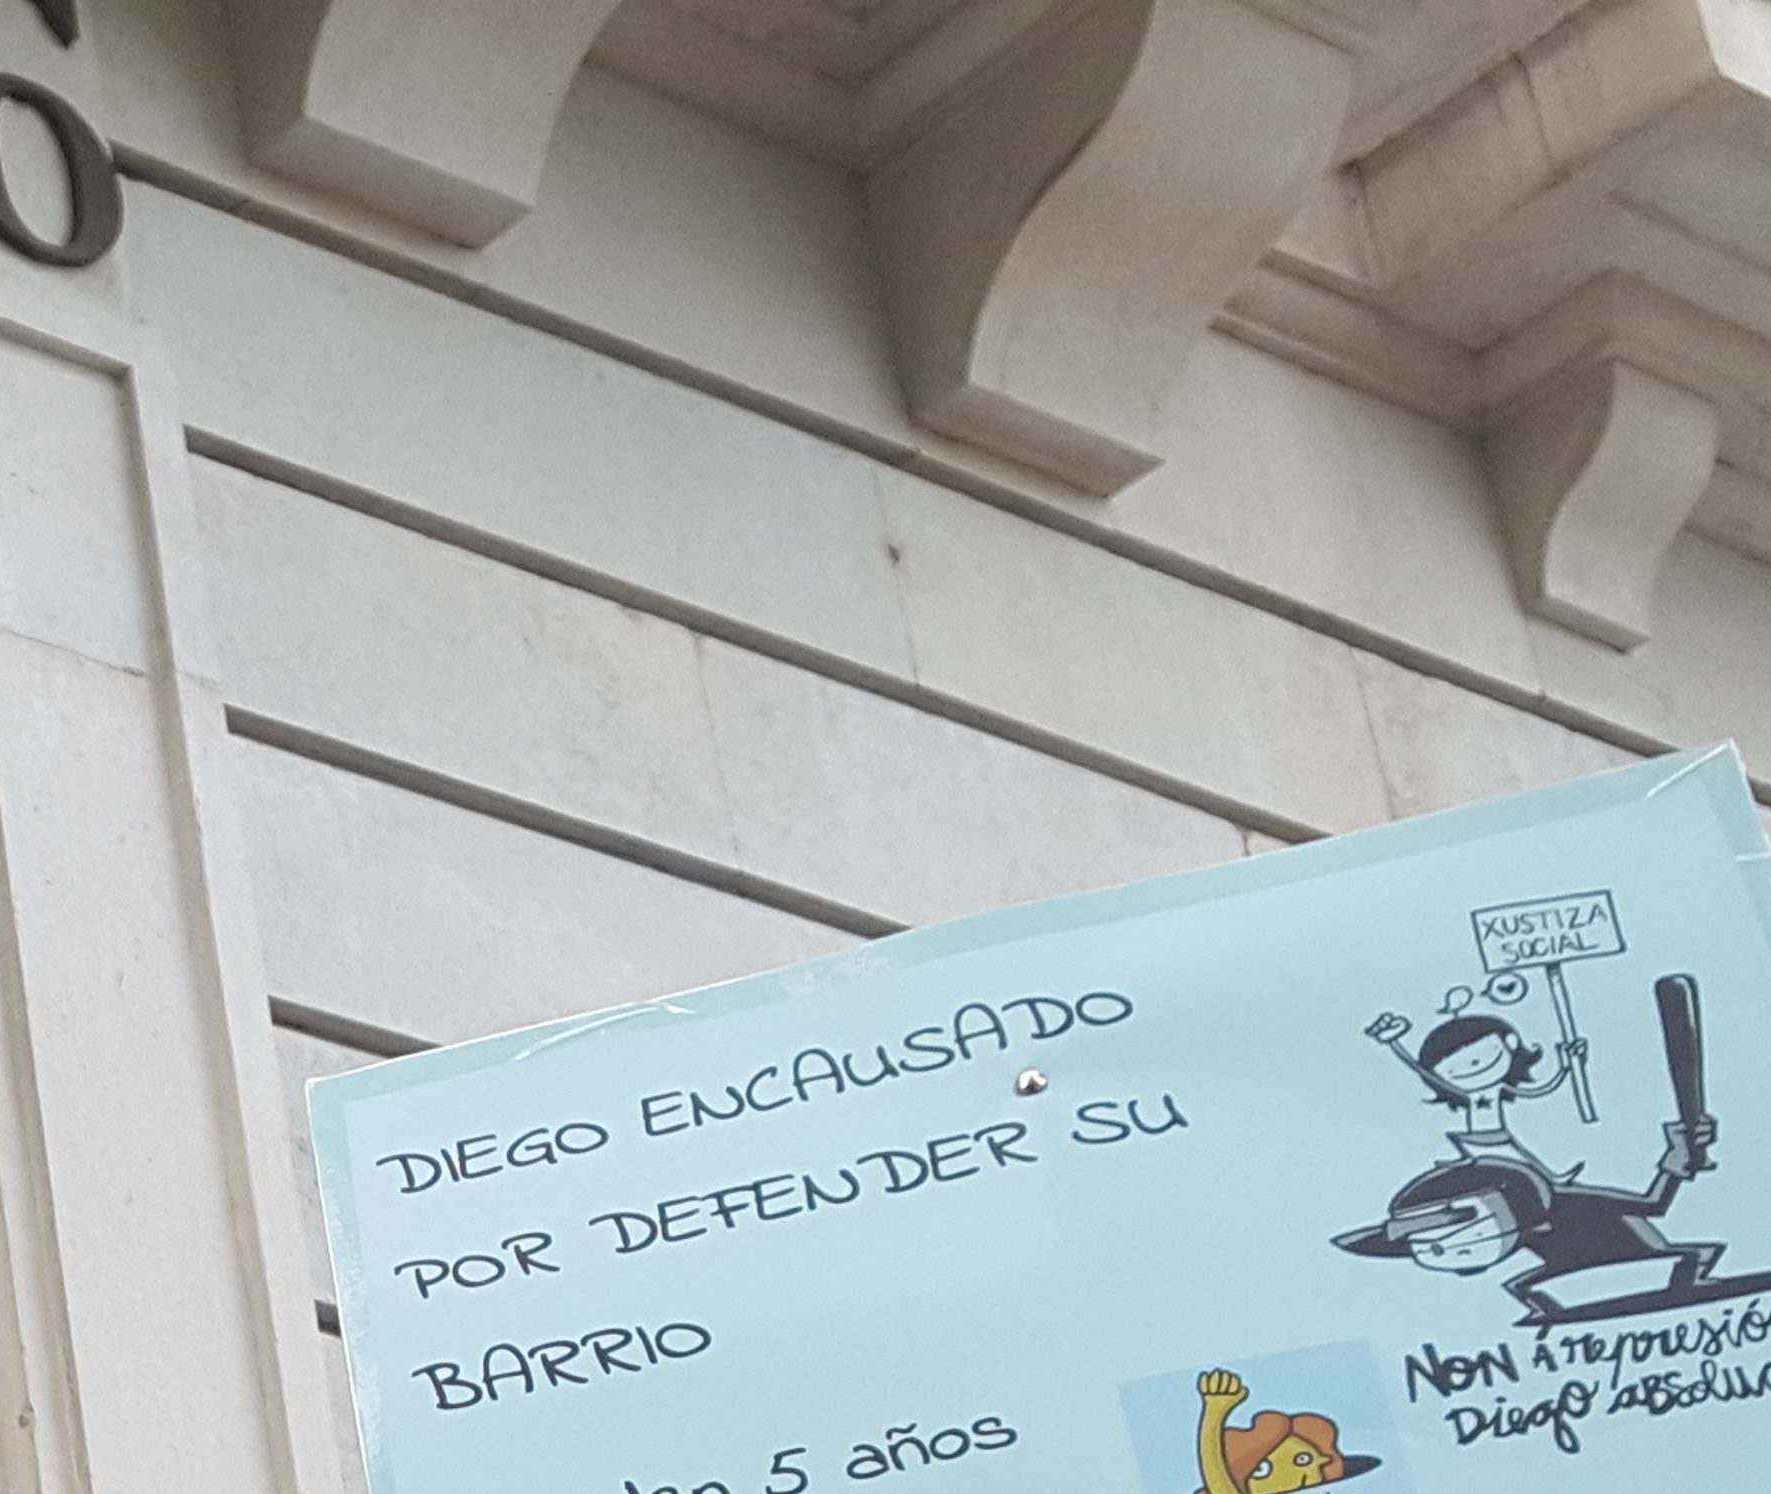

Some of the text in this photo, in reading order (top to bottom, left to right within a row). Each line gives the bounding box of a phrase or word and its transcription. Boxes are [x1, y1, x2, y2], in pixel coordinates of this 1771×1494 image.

[1481, 903, 1608, 941] XUSTIZA
[1501, 932, 1599, 964] SOCIAL
[374, 990, 1135, 1195] DIEGO ENCAUSADO
[393, 1091, 1190, 1300] POR DEFENDER SU
[411, 1322, 713, 1411] BARRIO
[1559, 1297, 1771, 1391] represió
[845, 1415, 1019, 1481] años
[1444, 1379, 1600, 1455] Diego
